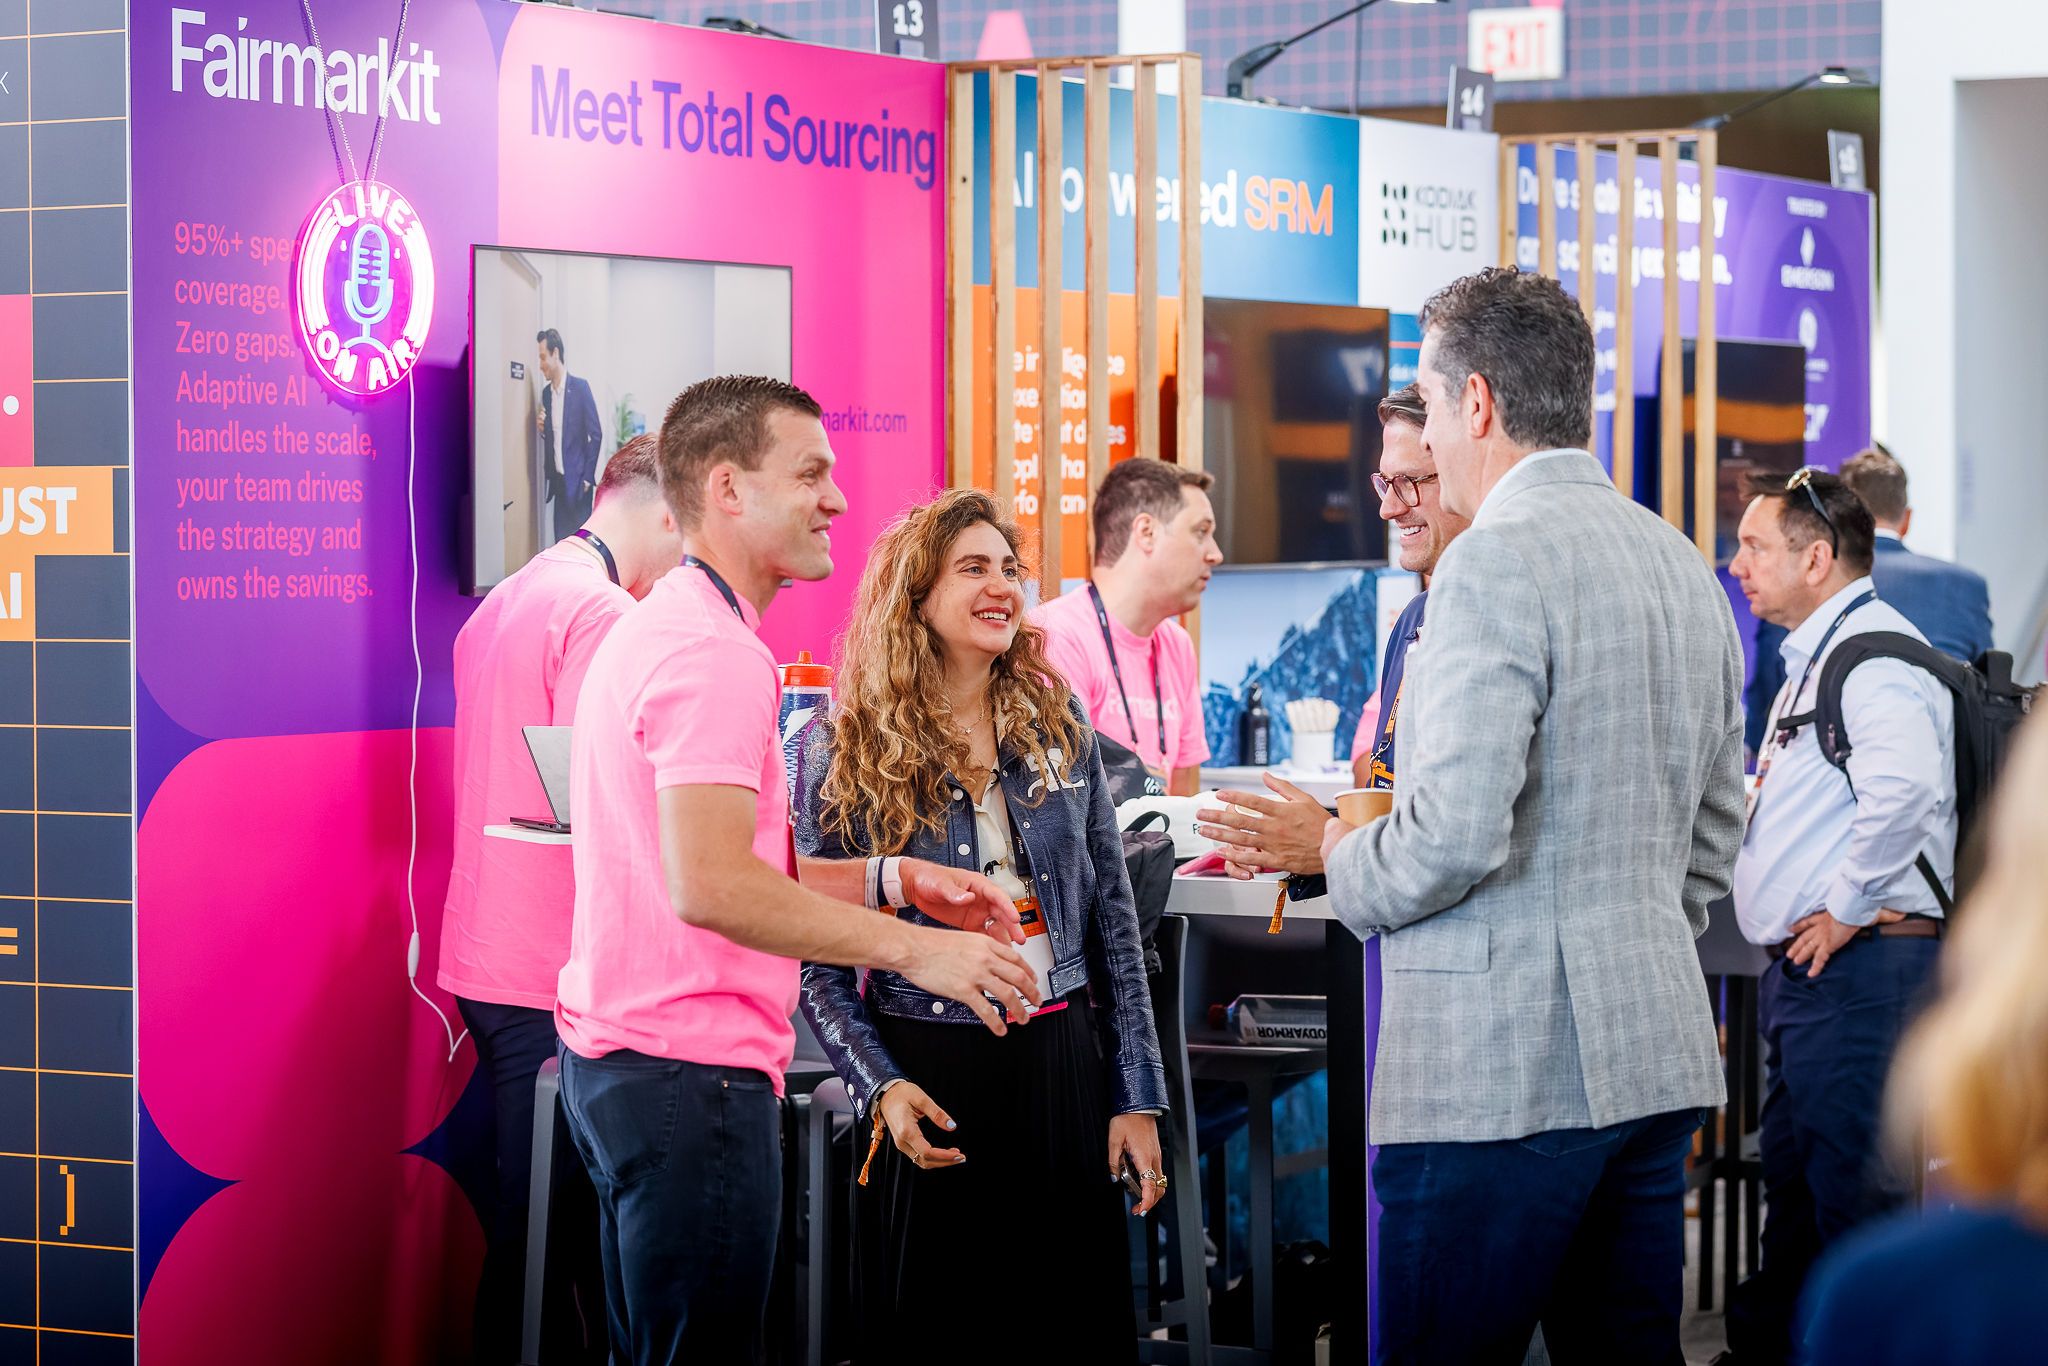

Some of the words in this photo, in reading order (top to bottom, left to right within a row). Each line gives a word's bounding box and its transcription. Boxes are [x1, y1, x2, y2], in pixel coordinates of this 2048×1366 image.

[893, 0, 924, 37] 13
[172, 8, 440, 125] Fairmarkit
[1484, 21, 1549, 74] EXIT
[530, 64, 642, 146] Meet
[652, 80, 753, 158] Total
[763, 94, 936, 191] Sourcing
[332, 185, 412, 236] LIVE
[1245, 175, 1333, 236] SRM
[175, 221, 243, 257] 95%+
[250, 236, 298, 266] spe
[1414, 214, 1478, 252] HUB
[175, 279, 286, 315] coverage.
[175, 320, 229, 355] Zero
[234, 331, 296, 363] gaps.
[316, 330, 358, 383] ON
[368, 338, 416, 390] AIR
[176, 370, 278, 410] Adaptive
[283, 374, 306, 406] AI
[176, 419, 267, 453] handles
[273, 421, 309, 454] the
[315, 424, 377, 460] scale,
[177, 476, 228, 508] your
[235, 472, 291, 502] team
[297, 470, 364, 503] drives
[177, 518, 215, 550] the
[221, 520, 316, 556] strategy
[322, 518, 361, 549] and
[177, 575, 238, 600] owns
[243, 566, 280, 599] the
[286, 566, 373, 603] savings.
[1256, 1026, 1327, 1040] ODYARMOR
